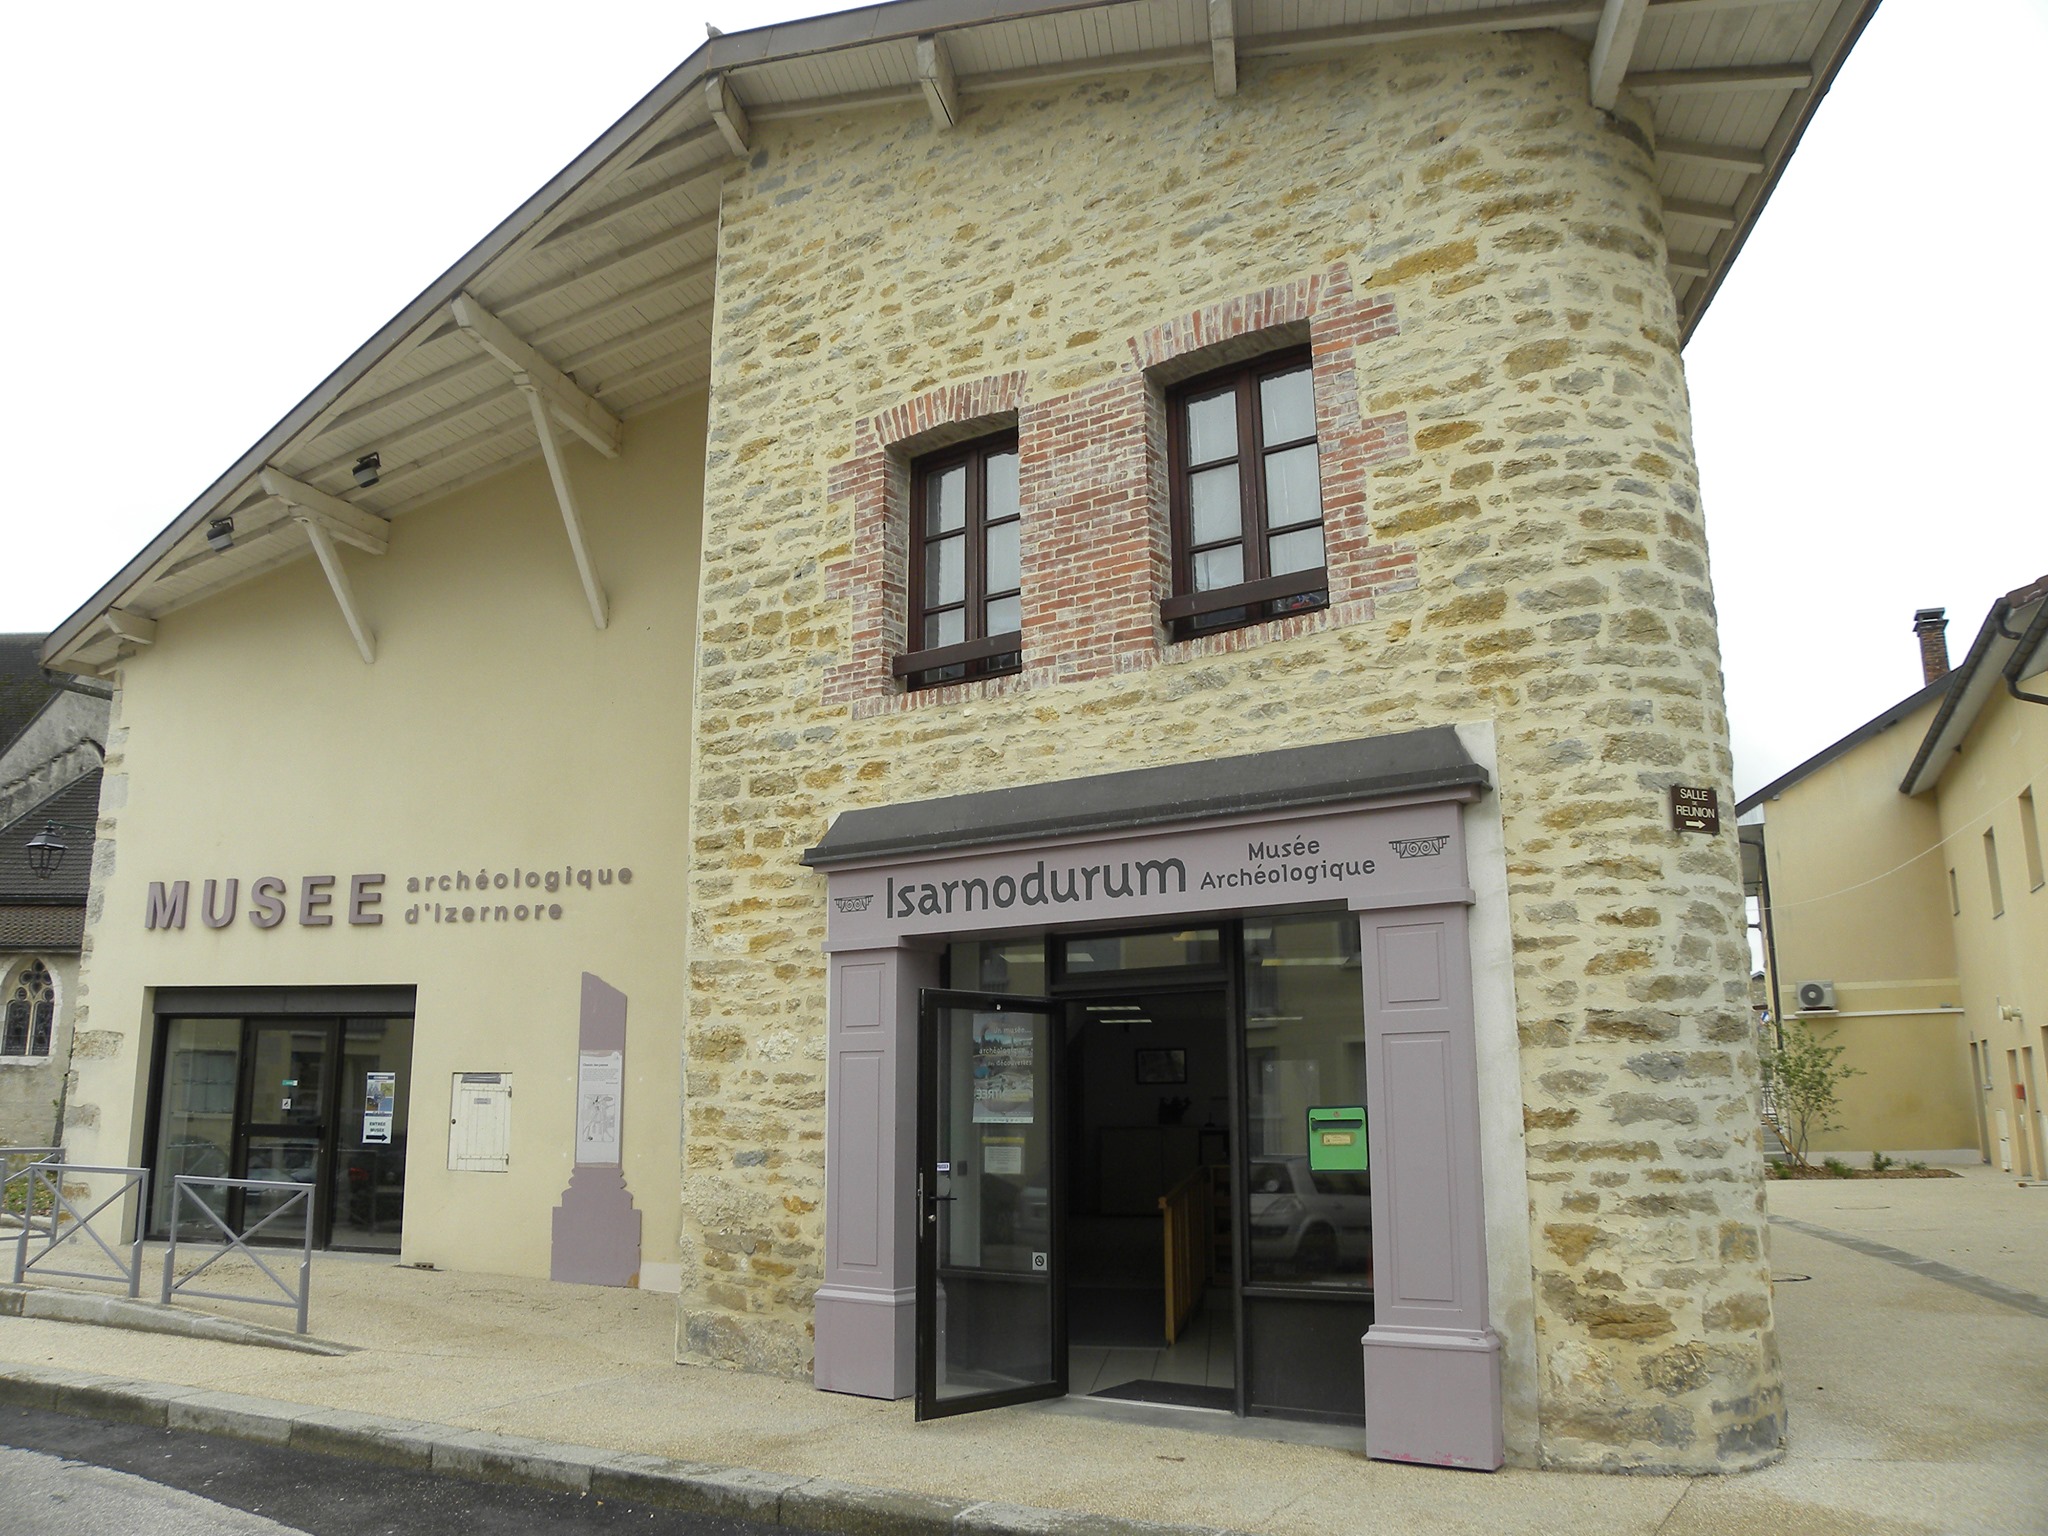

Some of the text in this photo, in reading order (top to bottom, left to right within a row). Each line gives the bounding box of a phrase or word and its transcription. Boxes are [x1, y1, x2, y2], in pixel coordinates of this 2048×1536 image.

[1680, 788, 1708, 800] SALLE
[1676, 805, 1715, 818] REUNION
[1248, 834, 1321, 861] Musée
[406, 865, 633, 893] archéologique
[1200, 858, 1376, 890] Archéologique
[144, 873, 387, 930] MUSEE
[886, 857, 1186, 919] Isarnodurum
[404, 902, 564, 925] d'Izernore
